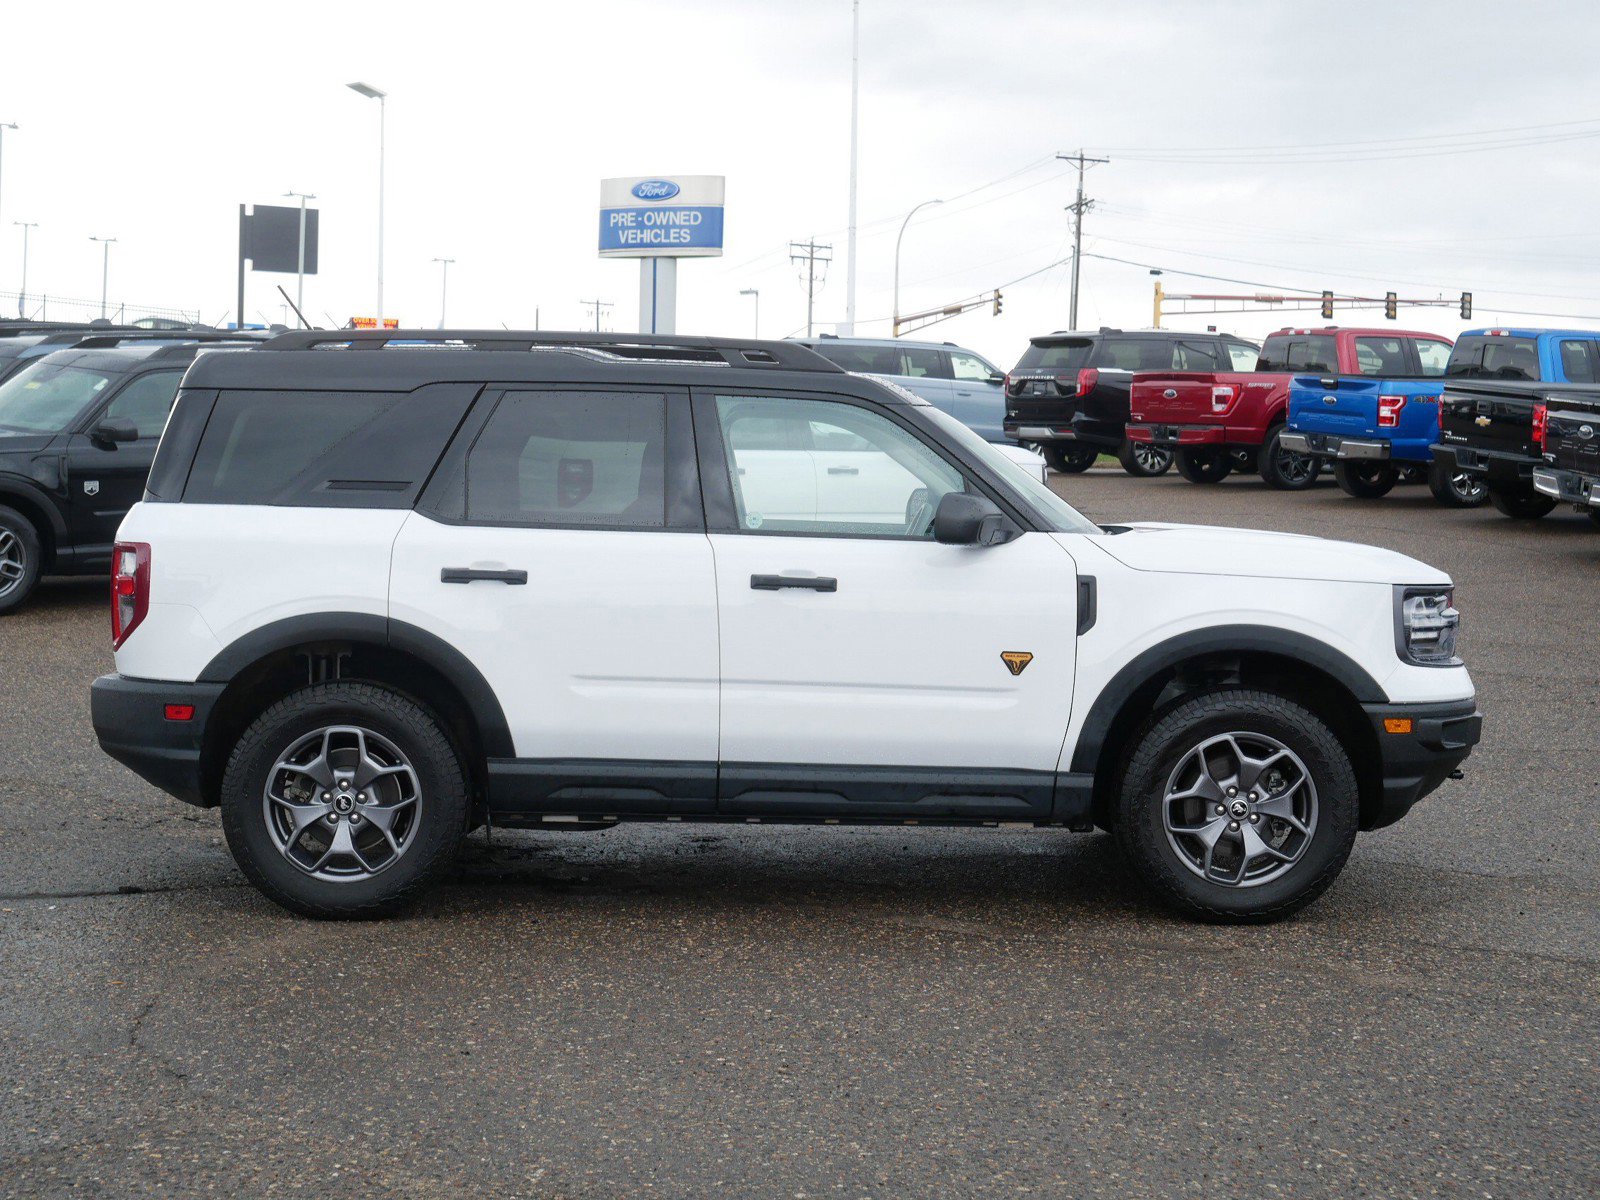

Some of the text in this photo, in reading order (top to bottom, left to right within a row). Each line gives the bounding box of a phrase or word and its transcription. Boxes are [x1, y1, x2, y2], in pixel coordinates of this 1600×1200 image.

[638, 181, 669, 198] Ford
[609, 211, 703, 228] PRE-OWNED
[618, 228, 692, 244] VEHICLES
